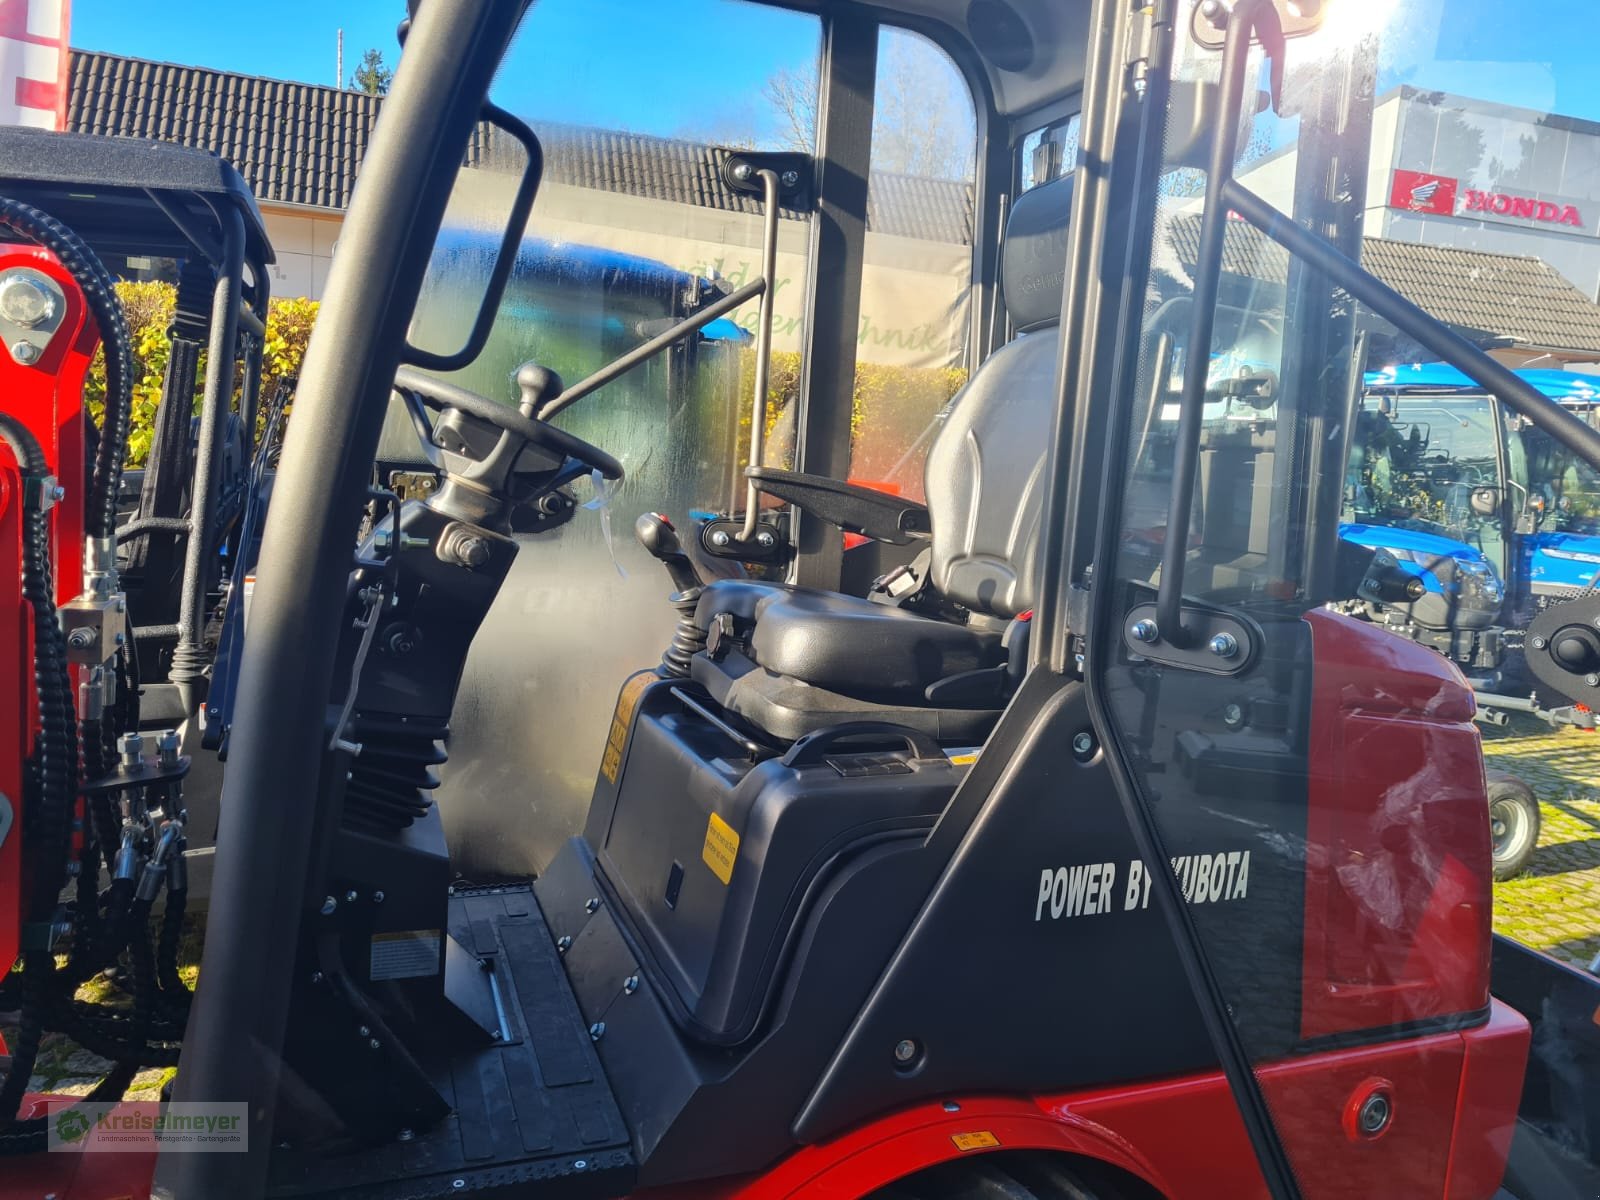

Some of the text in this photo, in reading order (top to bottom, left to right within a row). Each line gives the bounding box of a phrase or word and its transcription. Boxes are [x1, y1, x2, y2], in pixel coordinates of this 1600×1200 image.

[1463, 188, 1584, 227] HONDA
[1035, 862, 1116, 921] POWER
[1124, 859, 1152, 911] BY
